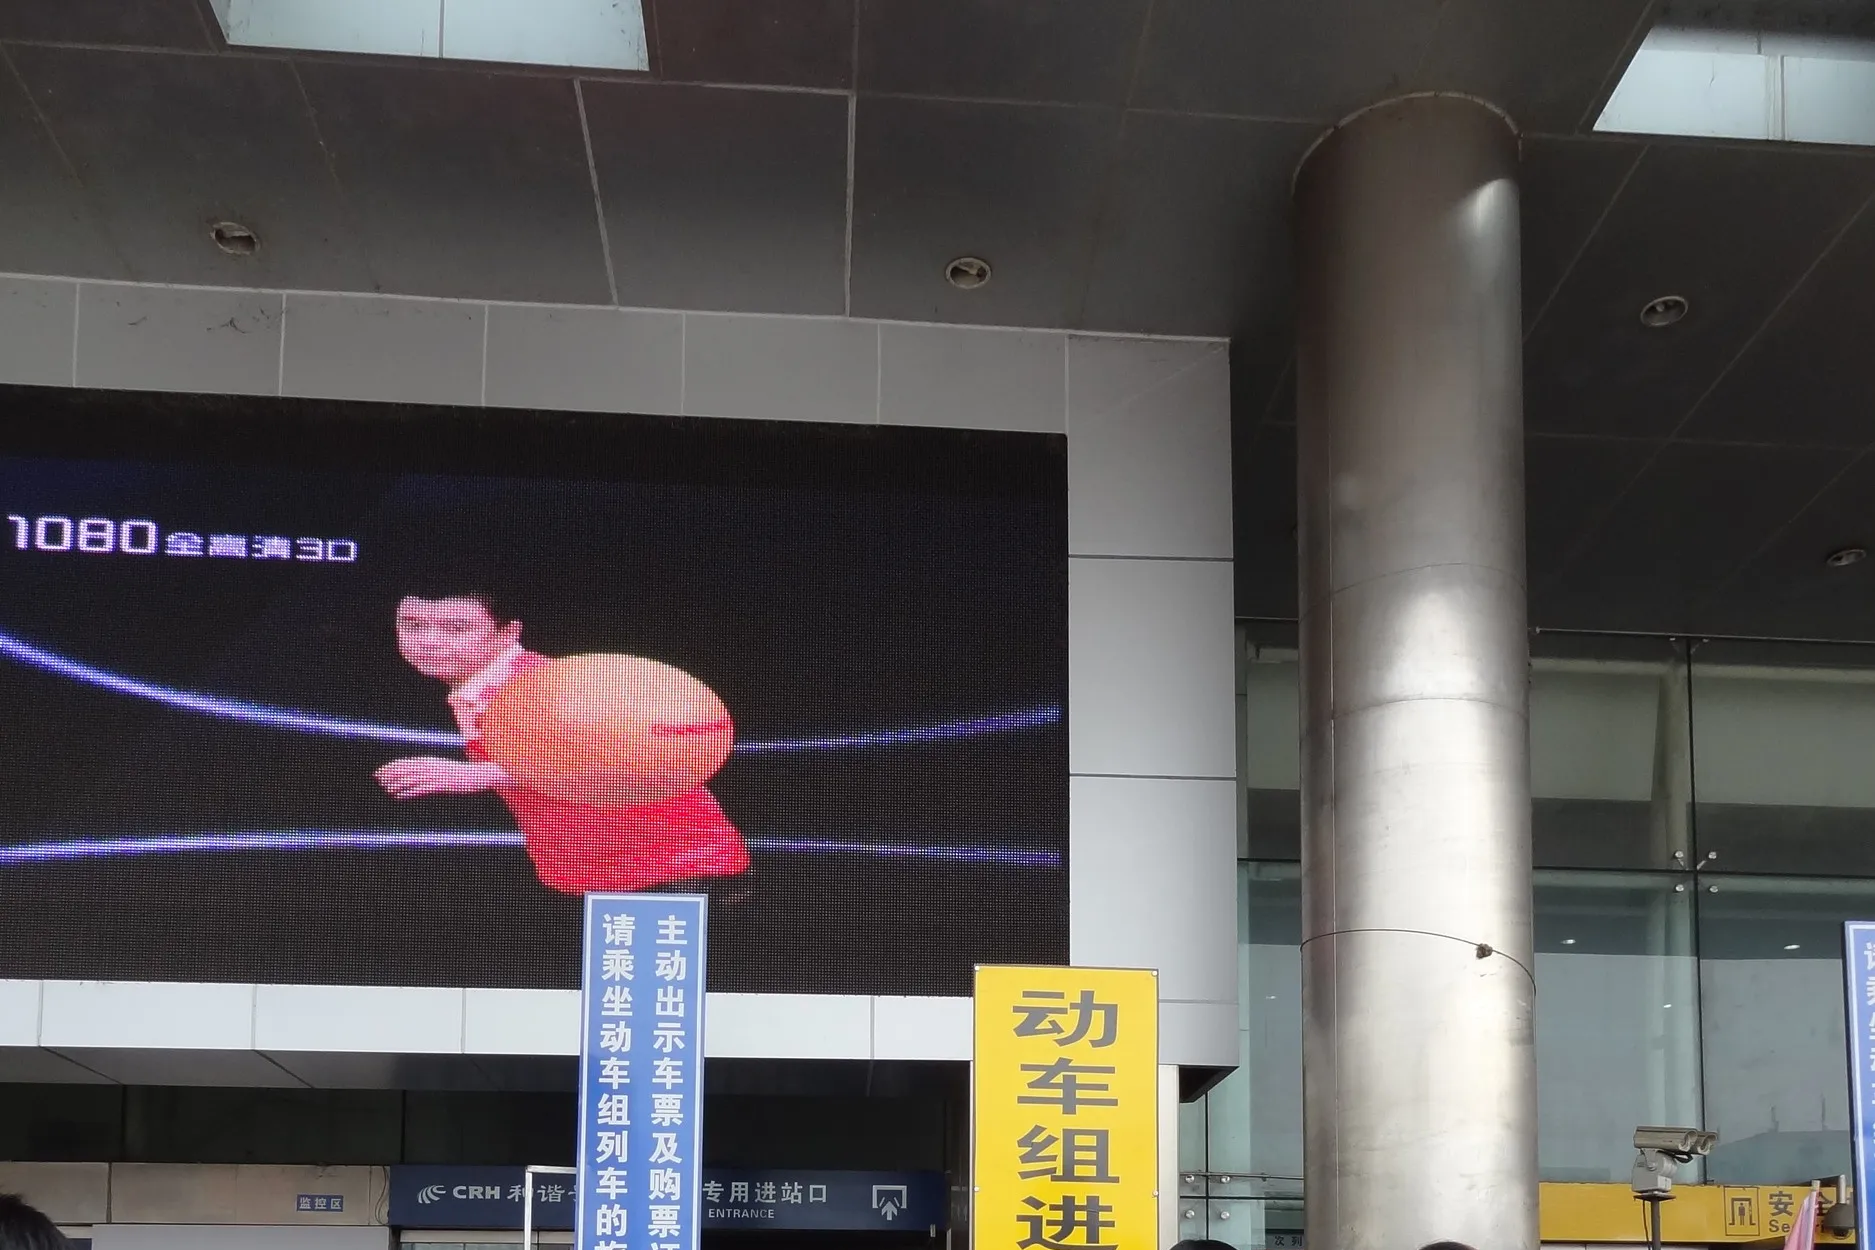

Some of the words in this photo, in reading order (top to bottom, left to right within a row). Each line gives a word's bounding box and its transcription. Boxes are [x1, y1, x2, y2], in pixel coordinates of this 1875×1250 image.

[452, 1185, 501, 1200] CRH
[506, 1184, 576, 1203] 和谐
[702, 1180, 827, 1204] 专用进站口
[299, 1196, 342, 1210] 监控区
[708, 1208, 775, 1219] ENTRANCE
